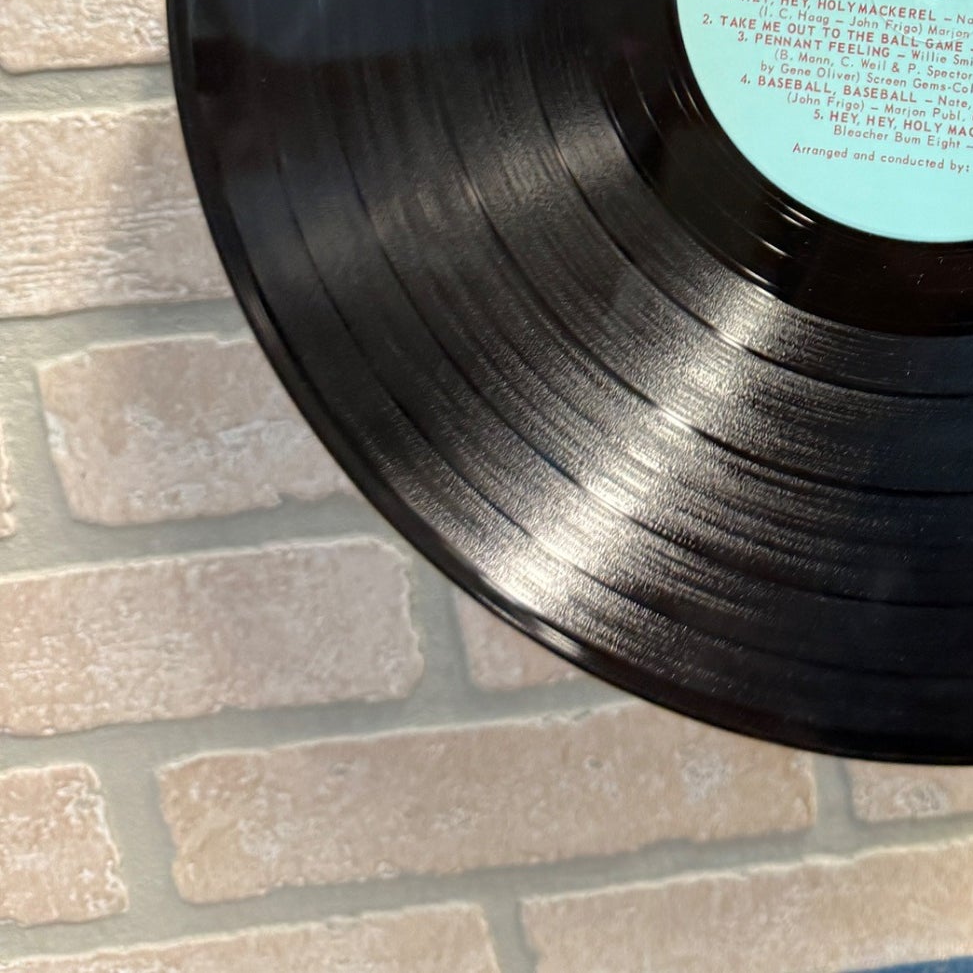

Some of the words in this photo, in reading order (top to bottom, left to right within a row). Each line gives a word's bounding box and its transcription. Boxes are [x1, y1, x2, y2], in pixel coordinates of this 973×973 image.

[702, 13, 713, 24] 2.
[720, 15, 757, 30] TAKE
[762, 20, 781, 32] ME
[787, 22, 816, 35] OUT
[822, 27, 841, 39] TO
[847, 29, 875, 42] THE
[881, 33, 919, 47] BALL
[925, 38, 964, 52] GAME
[779, 8, 792, 19] C.
[798, 10, 830, 26] Haag
[849, 16, 879, 28] John
[885, 19, 923, 34] Frigo)
[928, 25, 971, 38] Marjon
[737, 30, 748, 42] 3.
[755, 32, 823, 50] PENNANT
[828, 41, 890, 58] FEELING
[911, 49, 947, 63] Willie
[760, 60, 775, 74] by
[780, 63, 812, 76] Gene
[817, 67, 860, 83] Oliver)
[866, 72, 907, 87] Screen
[775, 49, 793, 60] (B.
[798, 52, 834, 66] Mann,
[841, 56, 854, 67] C.
[861, 58, 887, 70] Weil
[891, 61, 900, 72] &
[908, 63, 921, 74] P.
[927, 65, 973, 80] Spector
[740, 73, 751, 84] 4.
[758, 75, 837, 96] BASEBALL,
[843, 84, 918, 103] BASEBALL
[938, 95, 972, 110] Nate,
[787, 91, 821, 105] (John
[827, 96, 865, 112] Frigo)
[884, 103, 926, 117] Marjon
[932, 107, 966, 121] Publ.
[813, 108, 824, 119] 5.
[829, 110, 860, 125] HEY,
[866, 114, 897, 130] HEY,
[903, 119, 943, 133] HOLY
[833, 124, 889, 140] Bleacher
[894, 131, 921, 144] Bum
[927, 135, 961, 150] Eight
[792, 142, 849, 159] Arranged
[853, 151, 876, 161] and
[880, 154, 945, 169] conducted
[950, 159, 970, 174] by:
